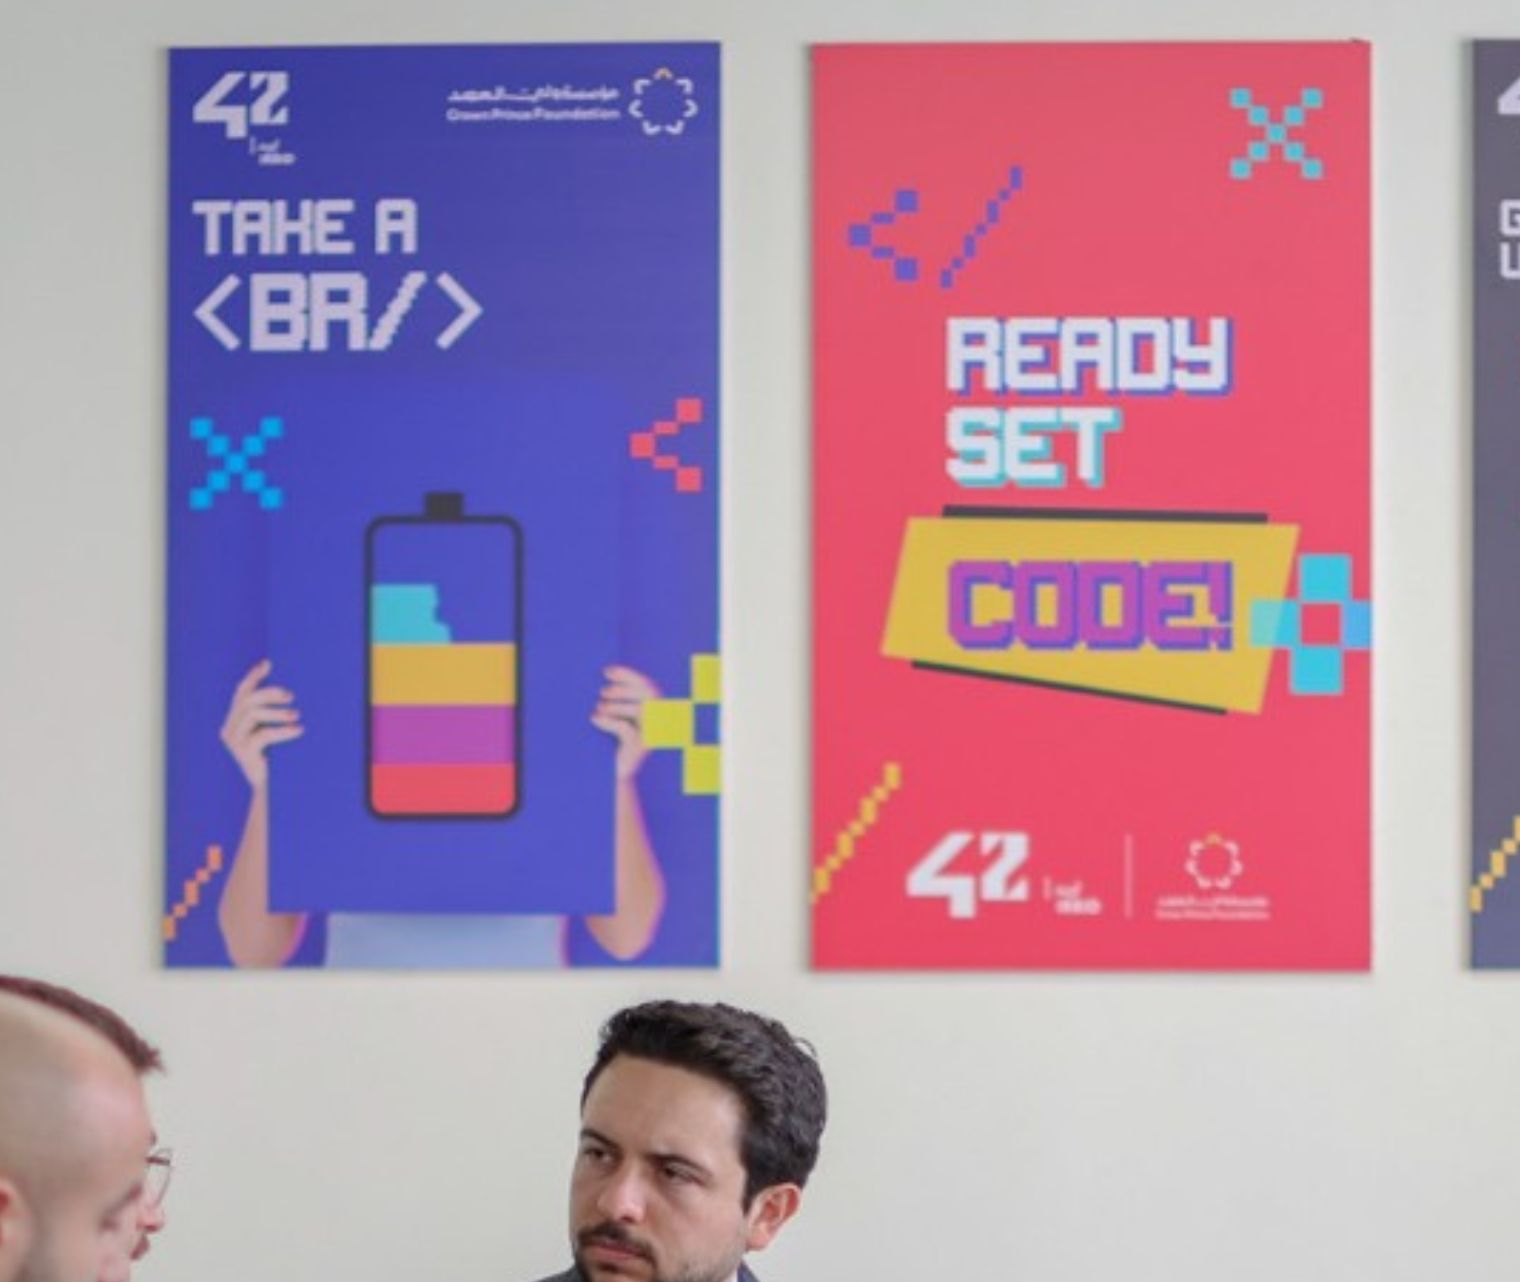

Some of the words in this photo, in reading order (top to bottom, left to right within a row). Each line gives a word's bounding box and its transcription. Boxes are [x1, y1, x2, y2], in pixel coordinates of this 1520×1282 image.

[192, 71, 289, 138] 42
[192, 198, 355, 256] TAKE
[375, 198, 418, 255] A
[946, 316, 1234, 397] READY
[946, 406, 1123, 489] SET
[947, 559, 1236, 653] CODE!
[906, 831, 1029, 919] 42
